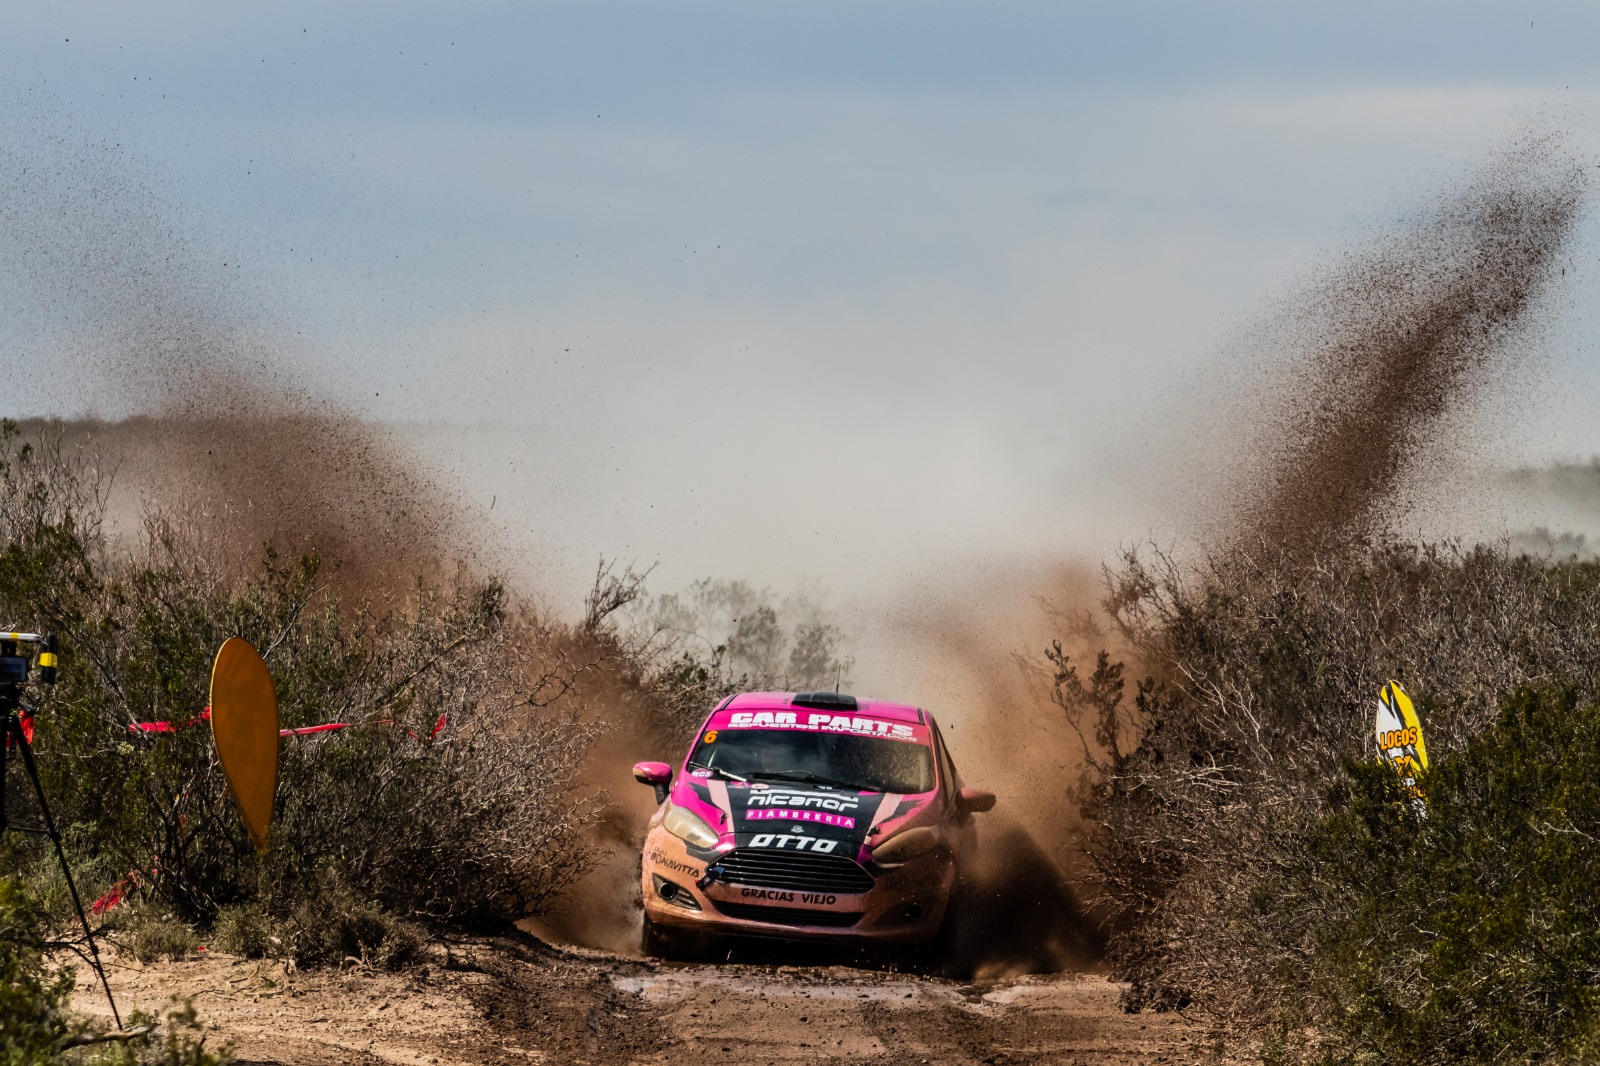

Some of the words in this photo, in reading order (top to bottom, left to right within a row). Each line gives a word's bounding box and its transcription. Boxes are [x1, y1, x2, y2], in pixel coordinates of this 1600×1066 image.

[730, 712, 797, 724] CAR
[808, 714, 913, 737] PARTS
[703, 730, 718, 744] 6
[1379, 726, 1417, 751] LOCOS
[747, 794, 858, 812] nicanor
[747, 811, 853, 827] FIAMBRERIA
[748, 834, 838, 853] OTTO
[650, 852, 700, 878] BONAVITTA
[741, 887, 794, 903] GRACIAS
[801, 893, 836, 905] VIEJO
